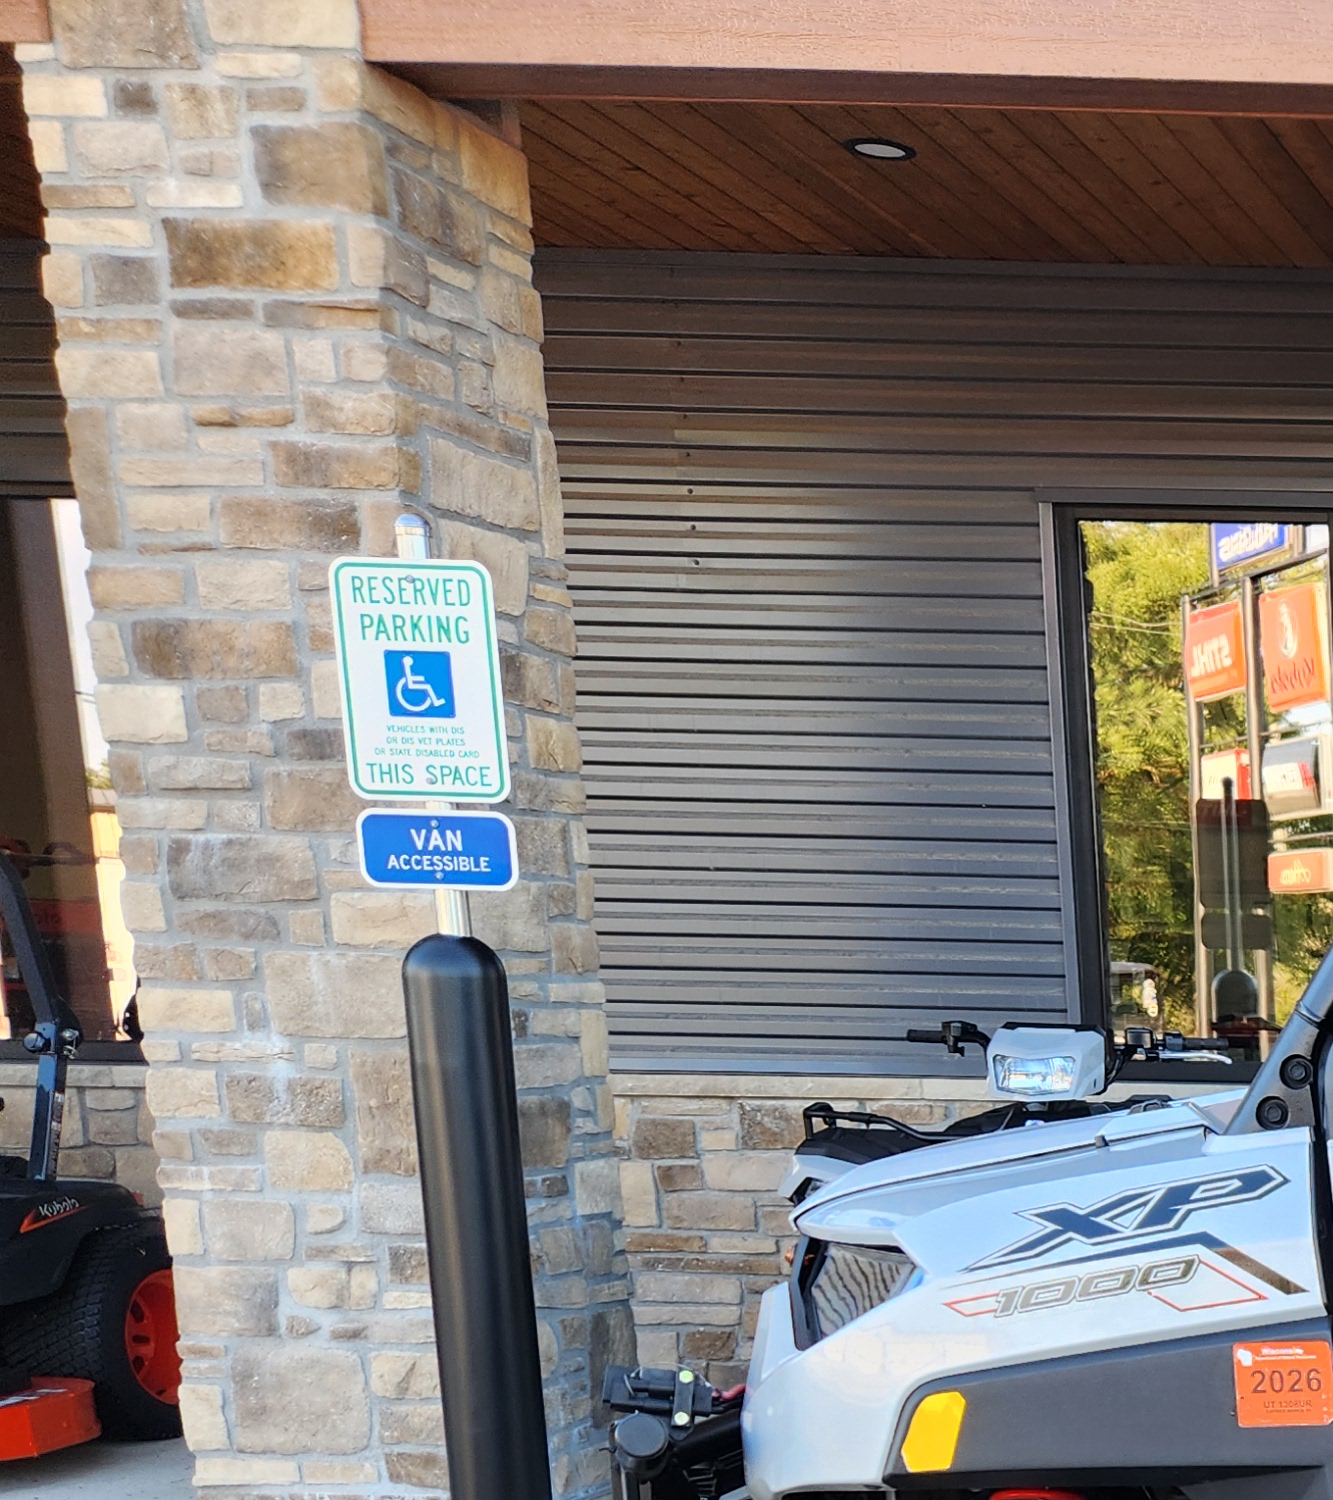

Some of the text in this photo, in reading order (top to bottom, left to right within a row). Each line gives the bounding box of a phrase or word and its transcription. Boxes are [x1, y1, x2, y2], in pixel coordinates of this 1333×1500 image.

[351, 575, 471, 607] RESERVED
[360, 613, 470, 645] PARKING
[386, 724, 465, 735] VEHICLES WITH DIS
[386, 736, 466, 746] OR DIS VET PLATES
[374, 747, 480, 758] OR STATE DISABLED CARD
[365, 762, 493, 787] THIS SPACE
[410, 828, 463, 852] VAN
[387, 854, 491, 873] ACCESSIBLE
[38, 1196, 80, 1217] Kubota
[957, 1163, 1291, 1274] XP
[994, 1254, 1201, 1318] 1000
[1250, 1368, 1322, 1394] 2026
